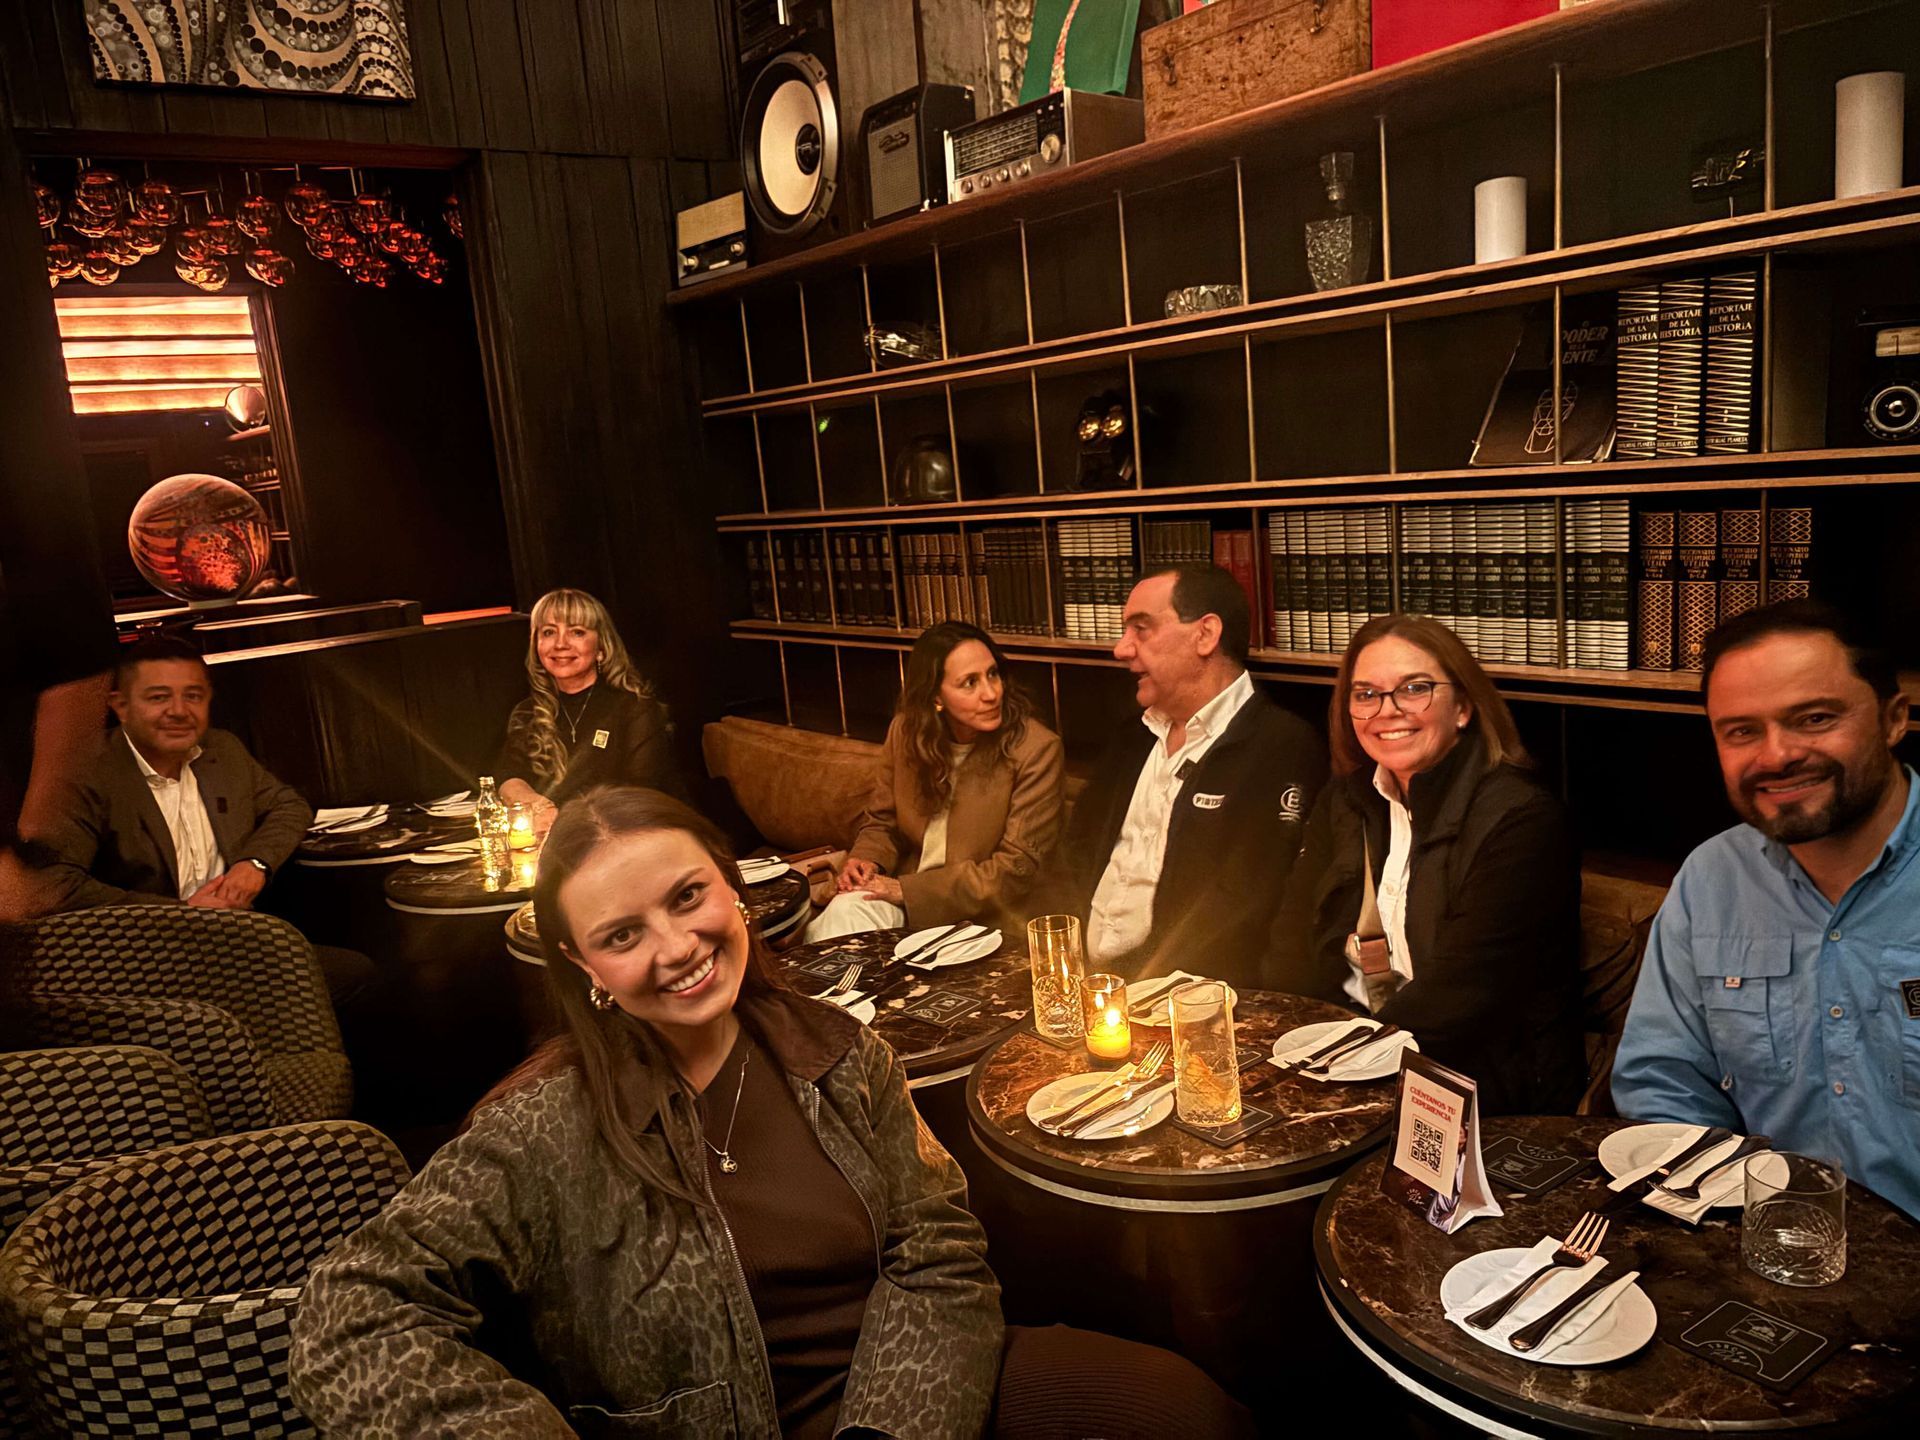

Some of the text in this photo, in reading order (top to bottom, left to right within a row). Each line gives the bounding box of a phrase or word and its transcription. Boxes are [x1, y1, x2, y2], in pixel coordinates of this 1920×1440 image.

[1660, 308, 1702, 321] REPORTAJE
[1709, 302, 1753, 316] REPORTAJE
[1617, 314, 1658, 327] REPORTAJE
[1730, 313, 1740, 321] LA
[1627, 325, 1647, 334] DE LA
[1669, 319, 1690, 329] DE LA
[1708, 321, 1752, 334] HISTORIA
[1617, 332, 1658, 345] HISTORIA
[1660, 327, 1702, 339] HISTORIA
[1411, 1096, 1452, 1122] EXPERIENCIA
[1448, 1105, 1457, 1115] TU
